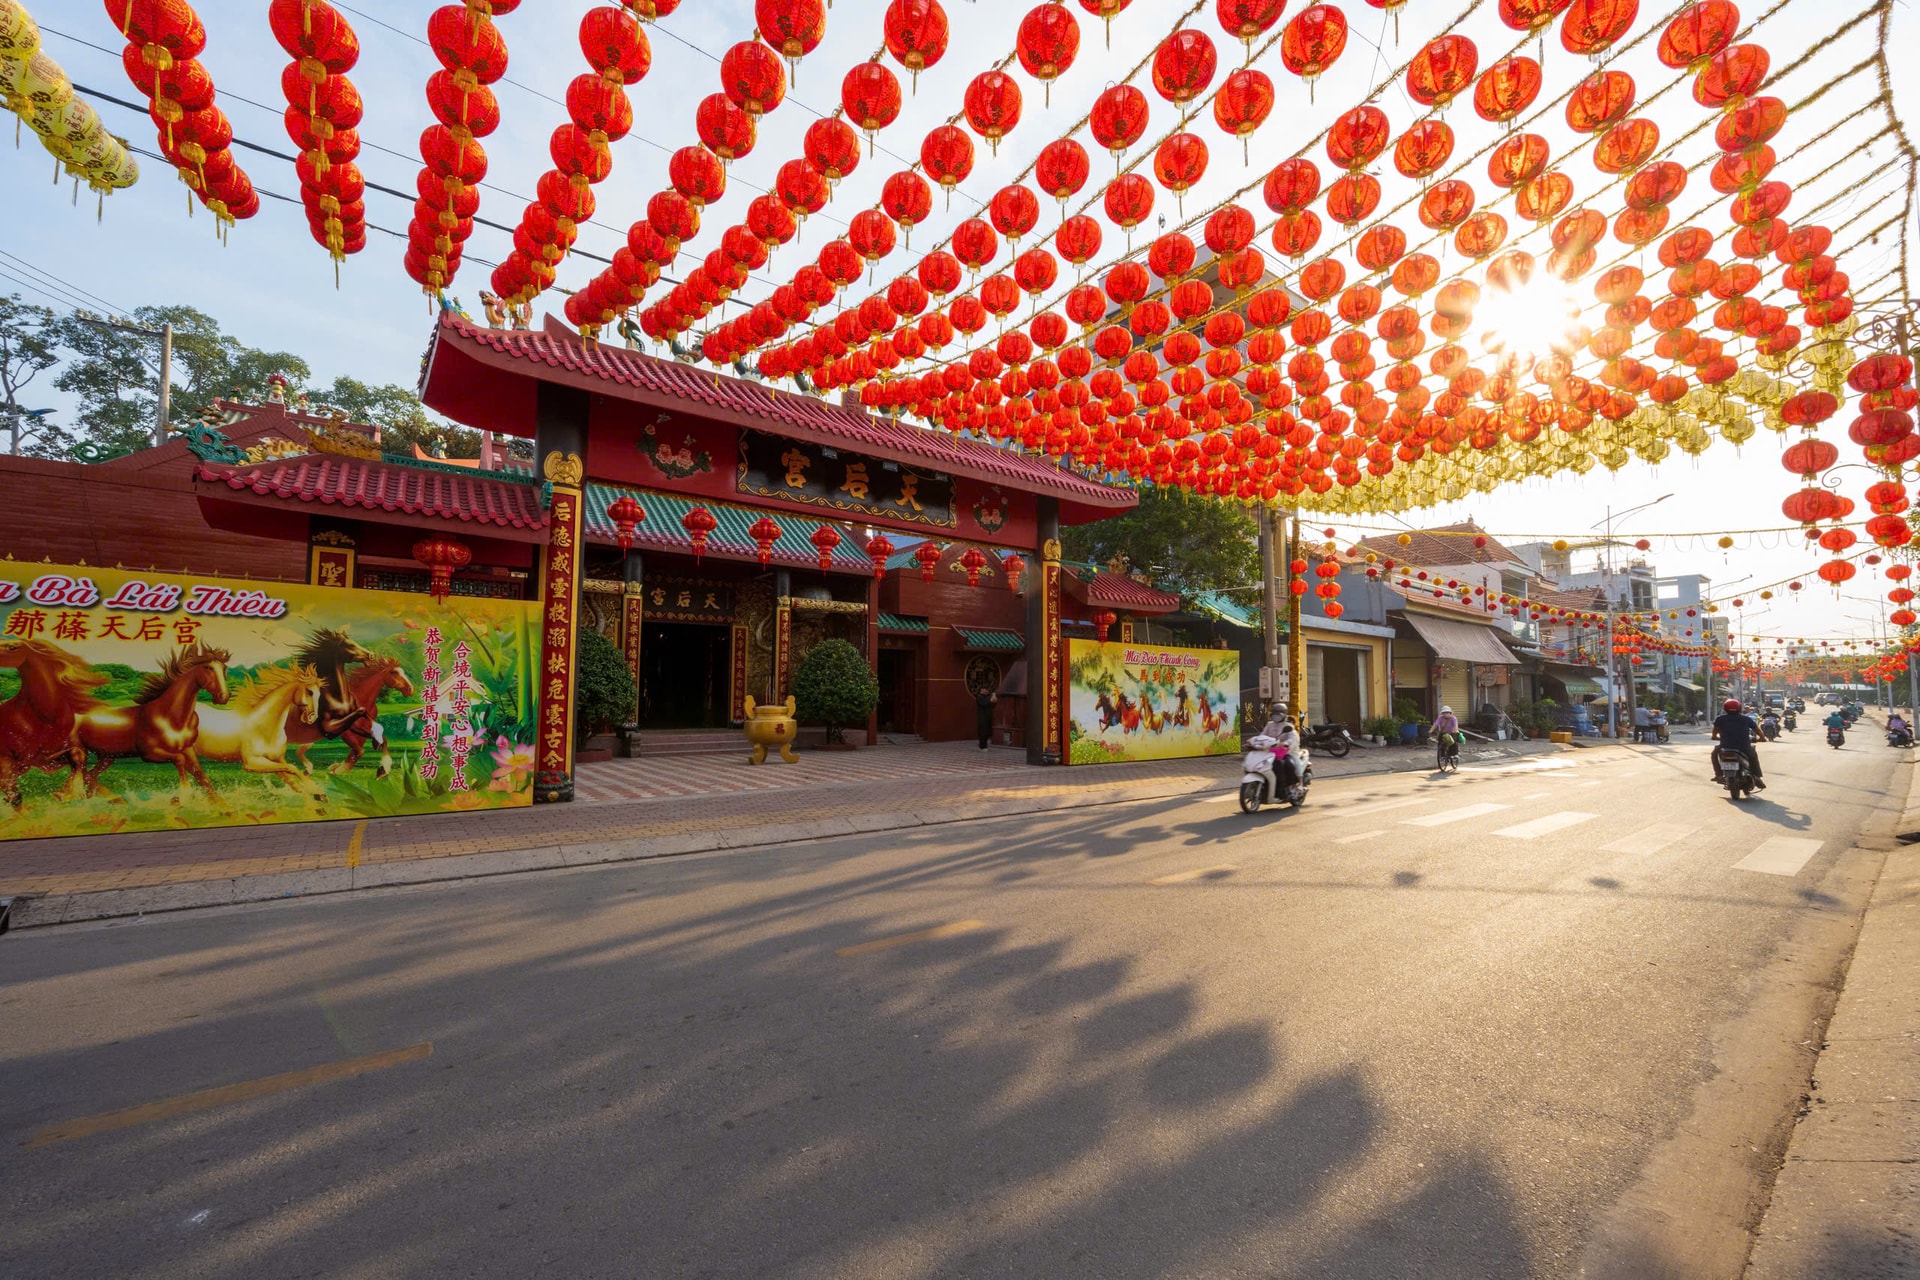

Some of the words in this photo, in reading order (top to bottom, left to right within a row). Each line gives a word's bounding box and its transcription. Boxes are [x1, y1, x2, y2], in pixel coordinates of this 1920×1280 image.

[28, 575, 98, 605] Bà
[105, 581, 182, 610] Lái
[185, 585, 286, 617] Thiêu
[450, 641, 472, 791] 合境平安心想事成
